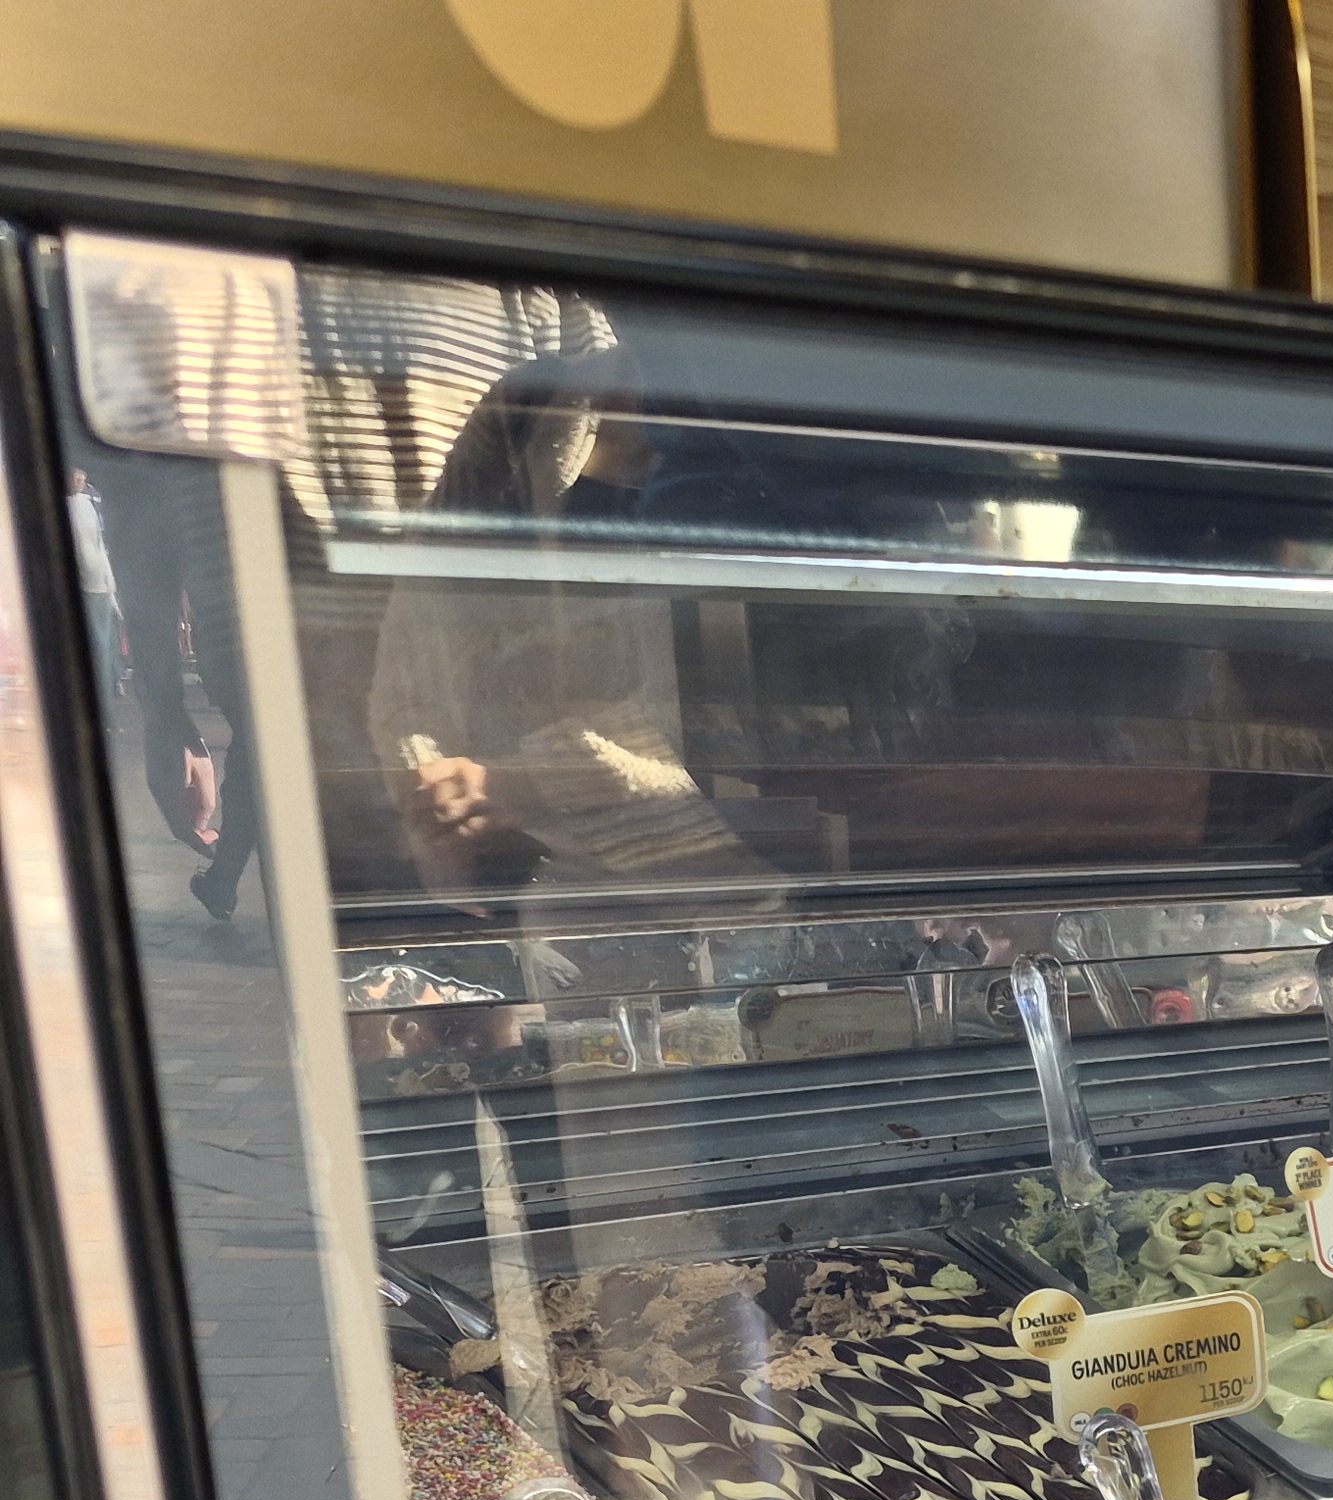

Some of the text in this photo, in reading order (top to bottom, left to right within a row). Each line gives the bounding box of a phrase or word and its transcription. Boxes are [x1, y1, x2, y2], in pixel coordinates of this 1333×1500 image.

[1018, 1312, 1077, 1331] Deluxe
[1071, 1331, 1241, 1380] GIANDUIA CREMINO
[1111, 1360, 1208, 1391] (CHOC HAZELNUT)
